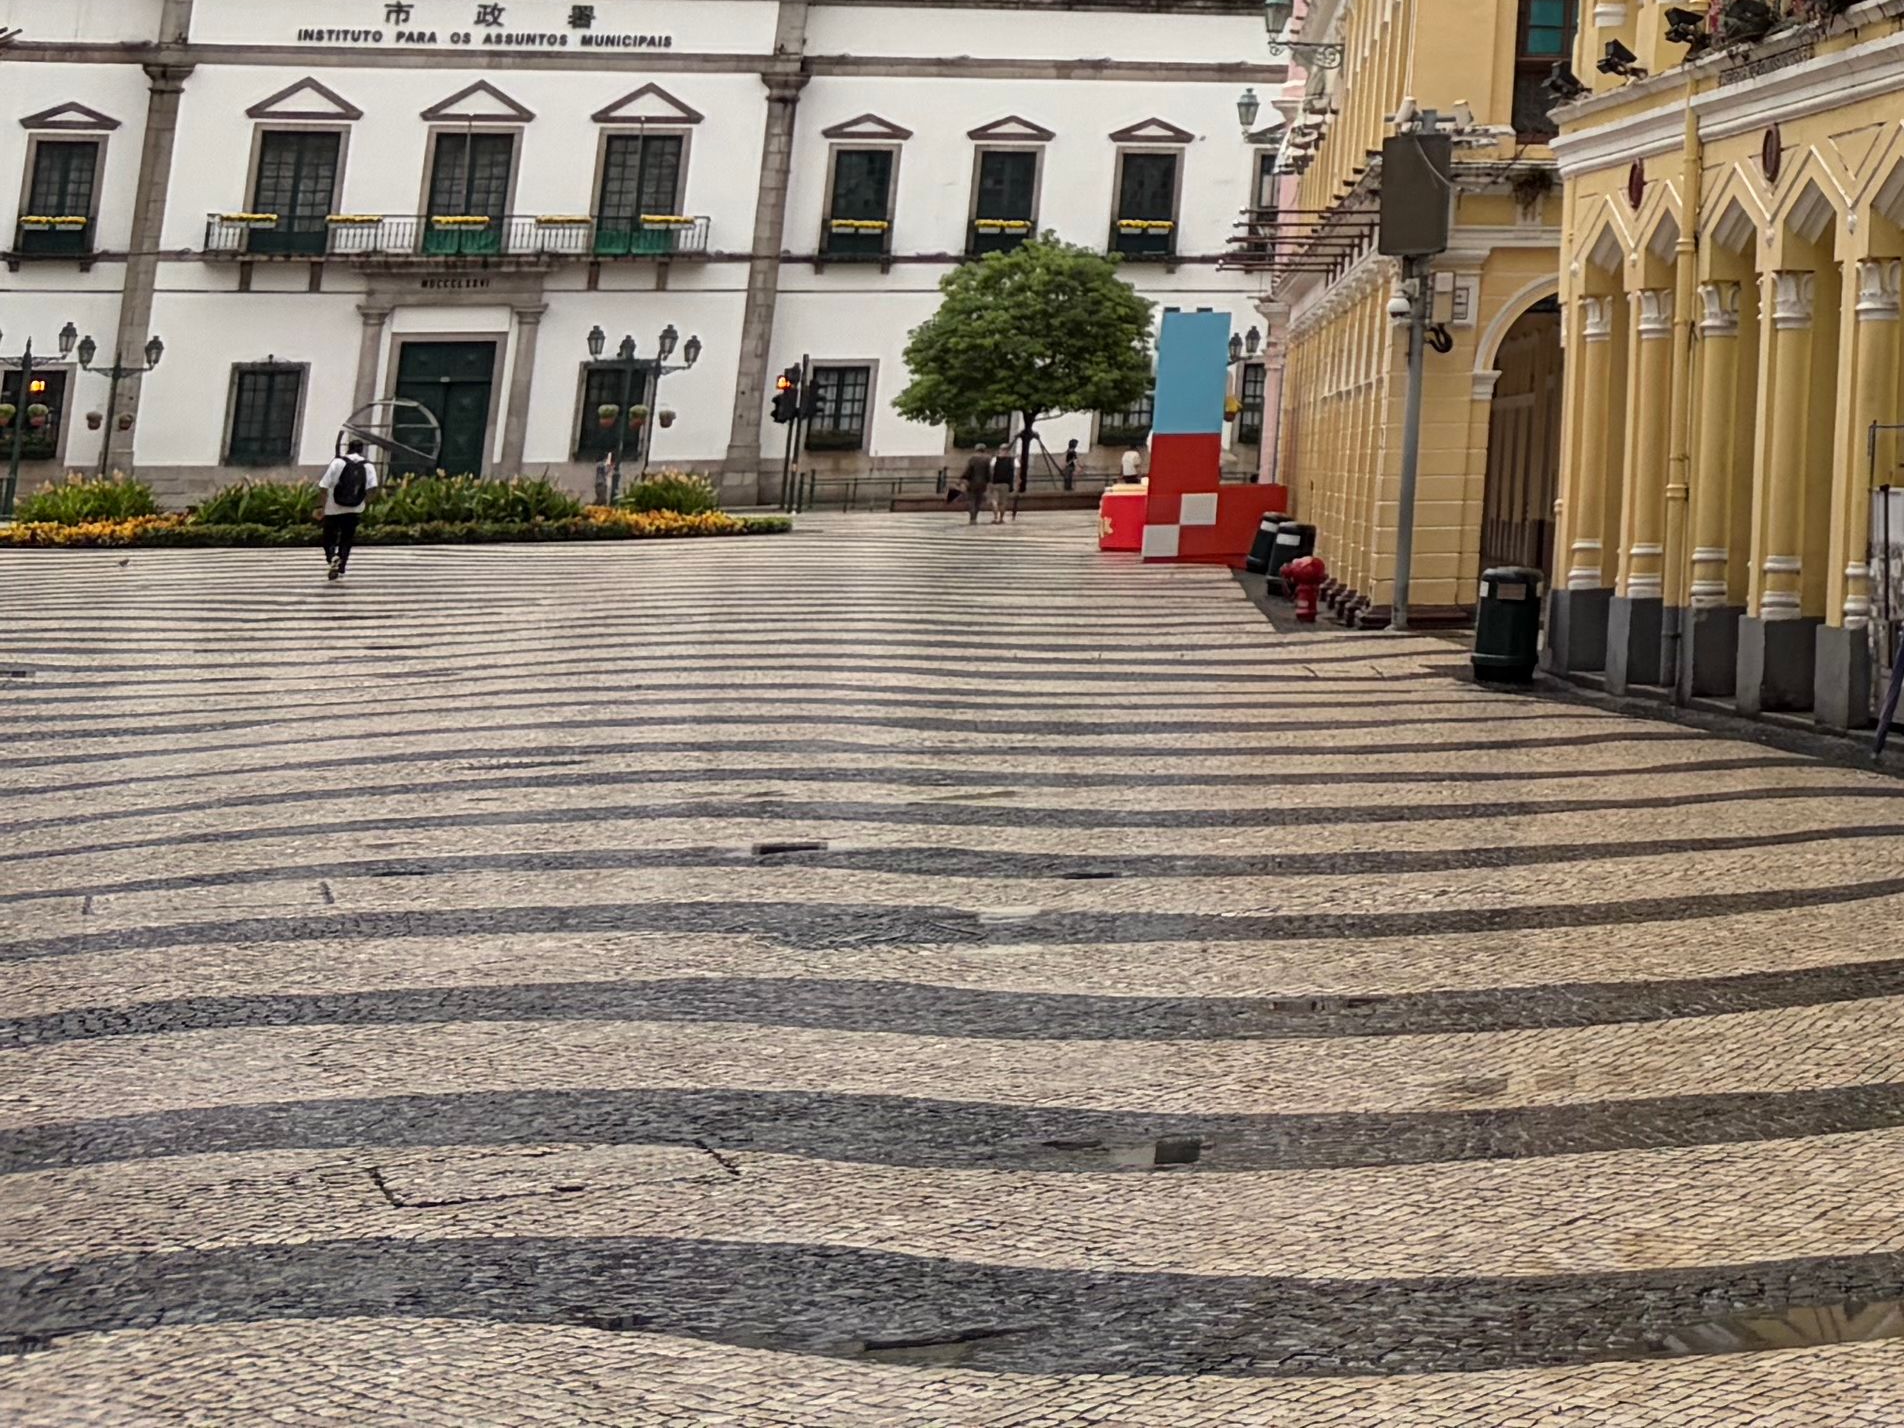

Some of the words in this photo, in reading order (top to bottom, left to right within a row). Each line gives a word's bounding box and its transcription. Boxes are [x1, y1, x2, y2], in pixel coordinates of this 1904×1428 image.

[384, 0, 597, 28] 市政署
[297, 28, 384, 43] INSTITUTO
[395, 31, 438, 44] PARA
[450, 31, 472, 44] OS
[482, 32, 568, 47] ASSUNTOS
[580, 34, 673, 49] MUNICIPAIS
